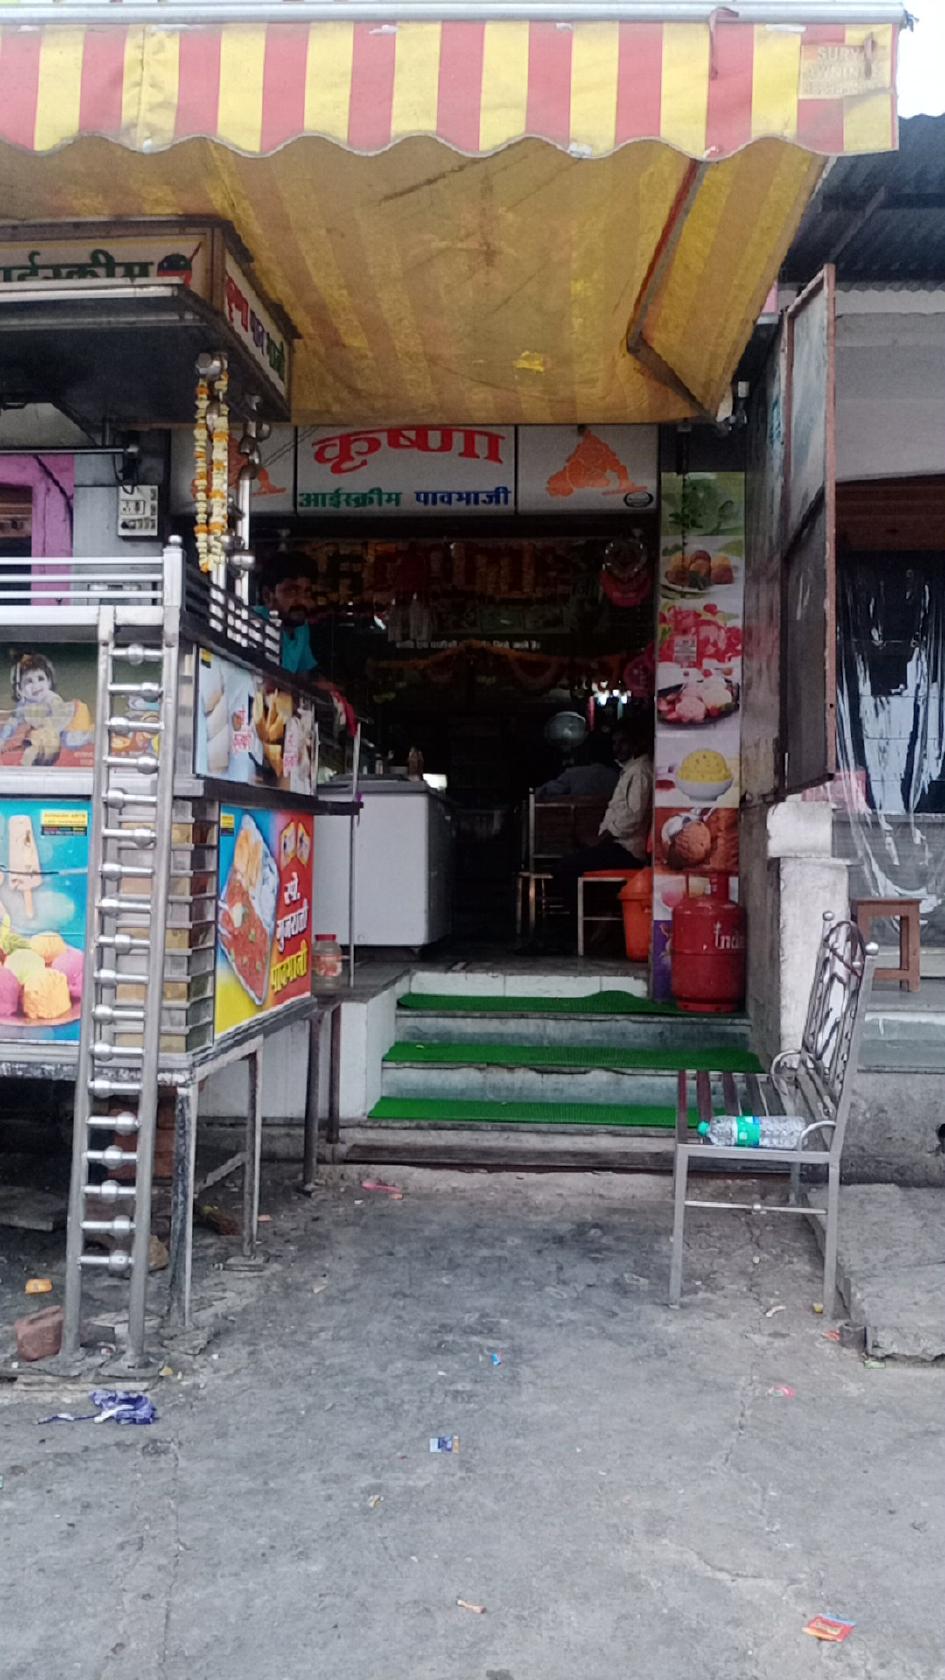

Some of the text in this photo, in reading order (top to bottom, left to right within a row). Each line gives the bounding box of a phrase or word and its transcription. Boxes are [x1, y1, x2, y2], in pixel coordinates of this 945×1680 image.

[311, 425, 506, 474] कृष्णा
[298, 485, 512, 508] आईस्क्रीम पावभाजी
